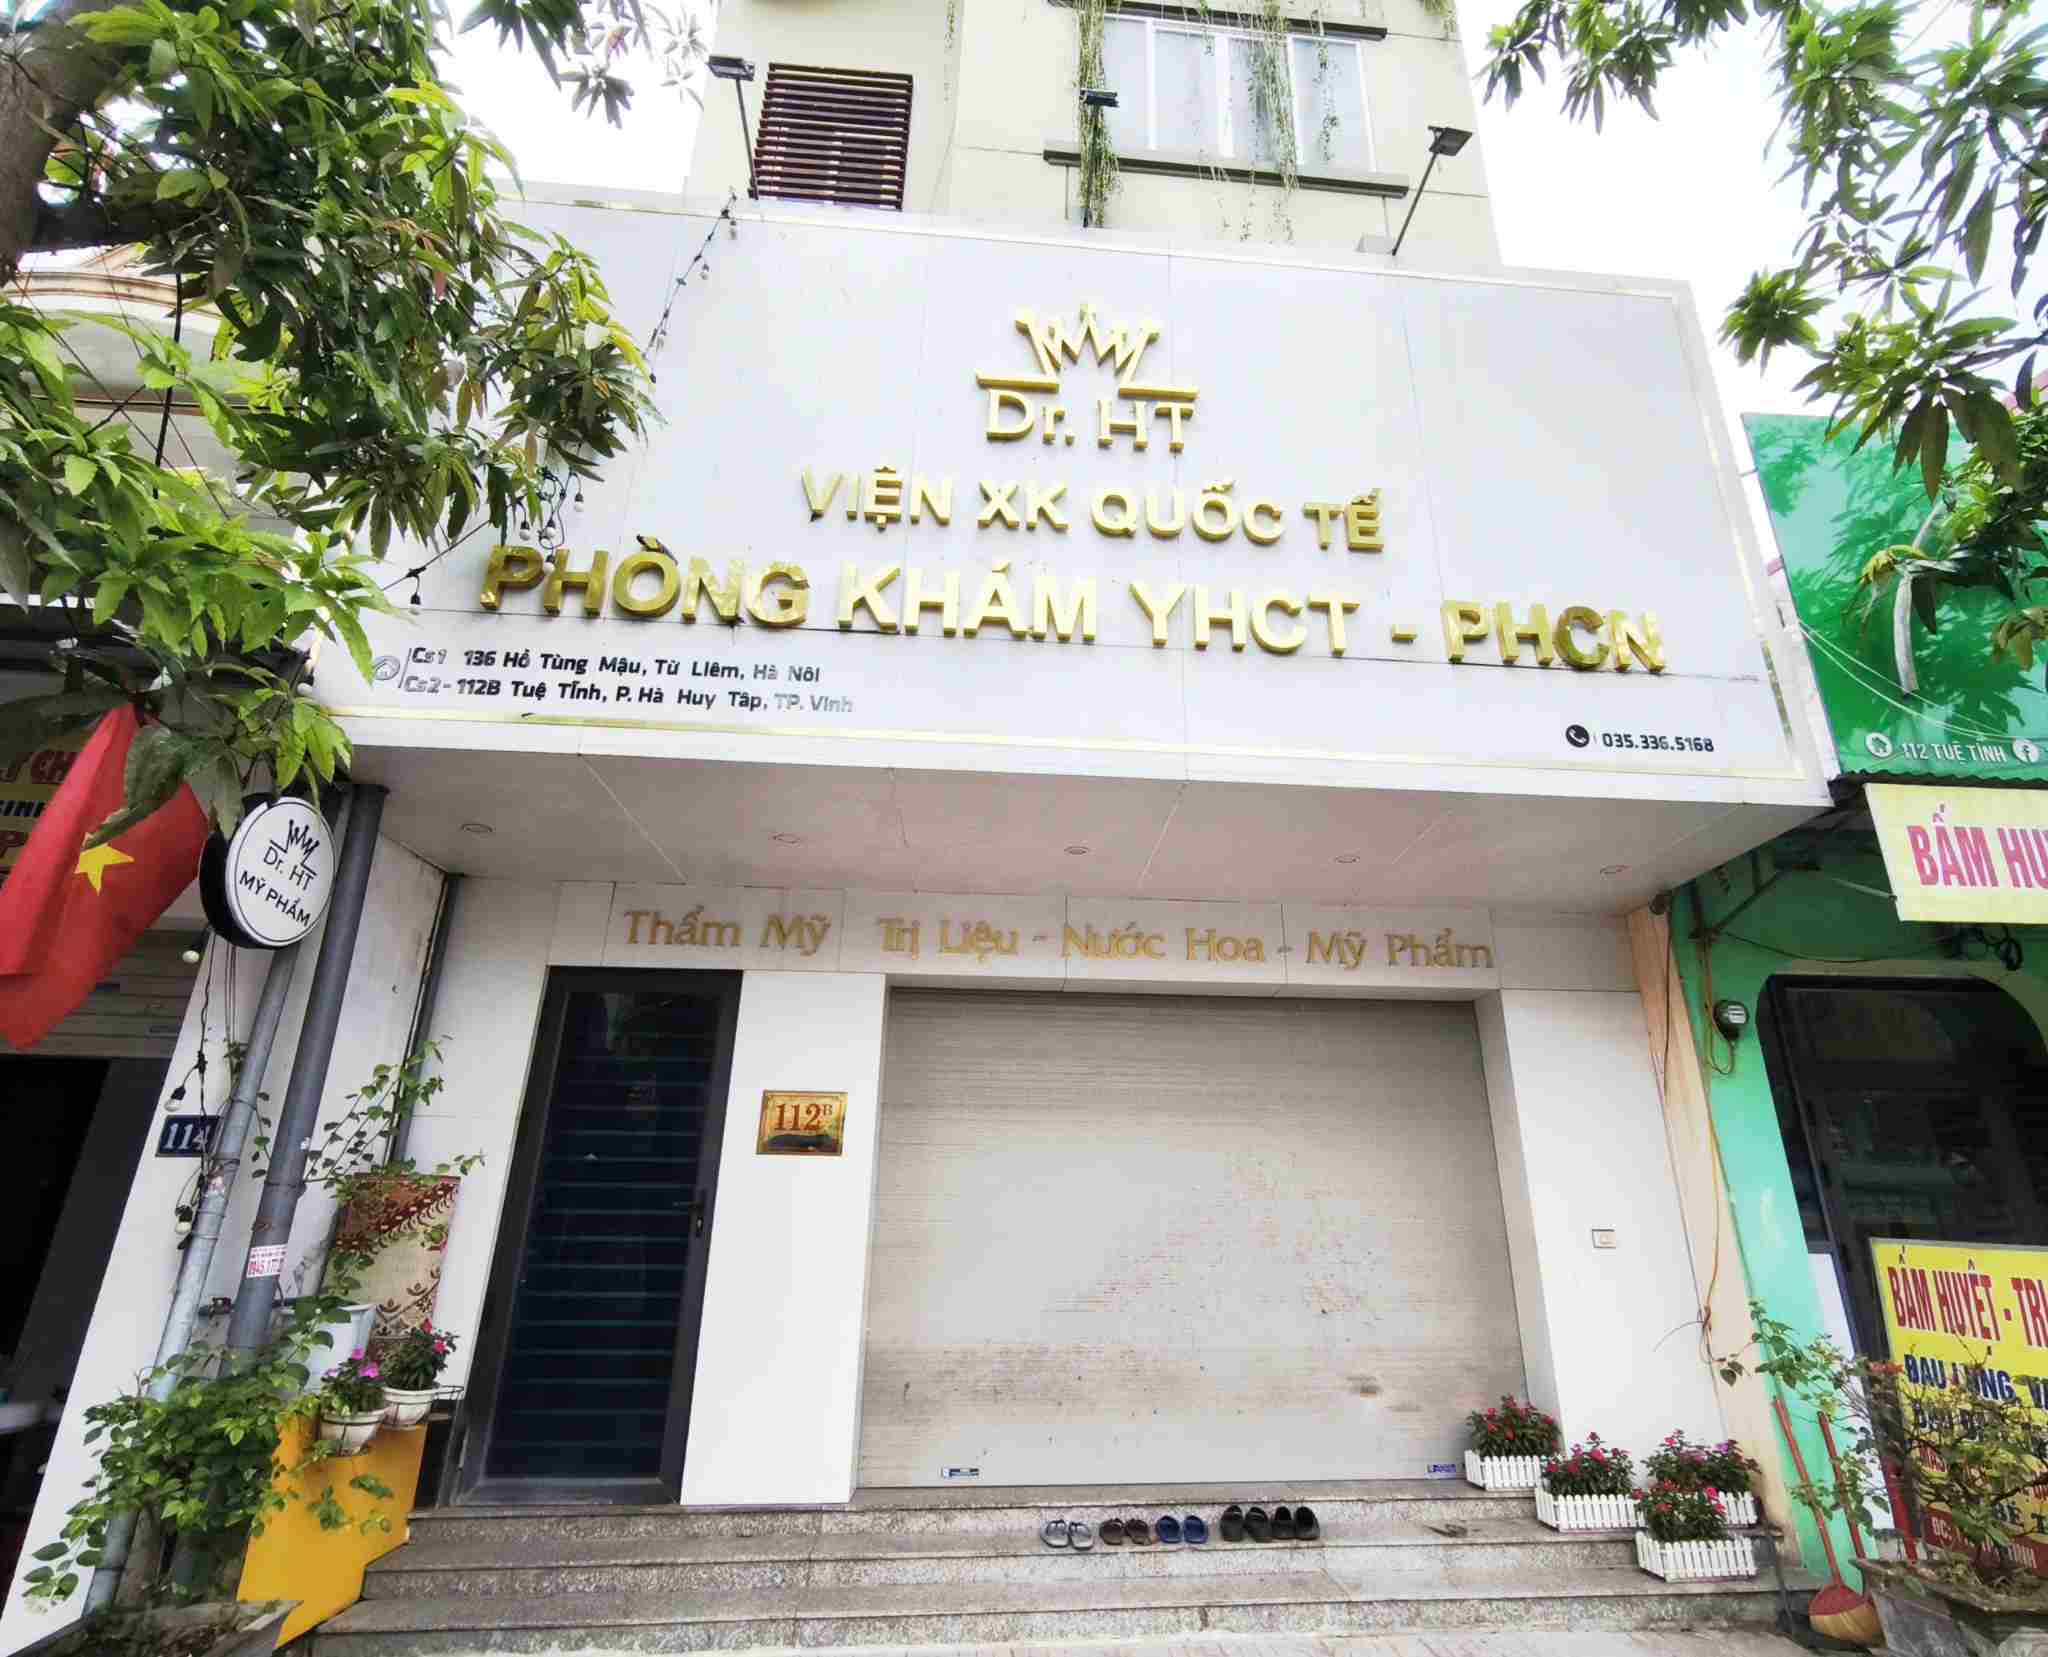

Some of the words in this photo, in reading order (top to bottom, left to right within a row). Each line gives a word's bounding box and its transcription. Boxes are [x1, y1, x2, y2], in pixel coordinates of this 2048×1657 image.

[986, 388, 1075, 446] Dr.
[1096, 399, 1197, 452] HT
[801, 464, 953, 531] VIỆN
[976, 477, 1069, 531] XK
[1090, 478, 1286, 545] QUỐC
[1302, 487, 1384, 552] TẾ
[478, 533, 810, 628] PHÒNG
[837, 561, 1097, 643] KHÁM
[1129, 582, 1360, 658] YHCT
[1440, 599, 1667, 674] PHCN
[456, 678, 501, 696] 112B
[510, 680, 548, 700] Tuệ
[676, 689, 717, 710] Huy
[464, 650, 497, 667] 136
[540, 653, 588, 675] Tùng
[598, 656, 647, 677] Mậu,
[655, 658, 681, 676] Từ
[1602, 732, 1715, 753] 035.336.5168
[263, 845, 285, 875] Dr.
[288, 864, 315, 891] HT
[1905, 802, 2001, 888] BẤM
[623, 904, 741, 948] Thẩm
[758, 912, 832, 957] Mỹ
[876, 916, 921, 960] Trị
[938, 914, 1021, 965] Liệu
[1060, 921, 1167, 960] Nước
[1184, 926, 1267, 963] Hoa
[1303, 928, 1368, 971] Mỹ
[1384, 927, 1496, 969] Phẩm
